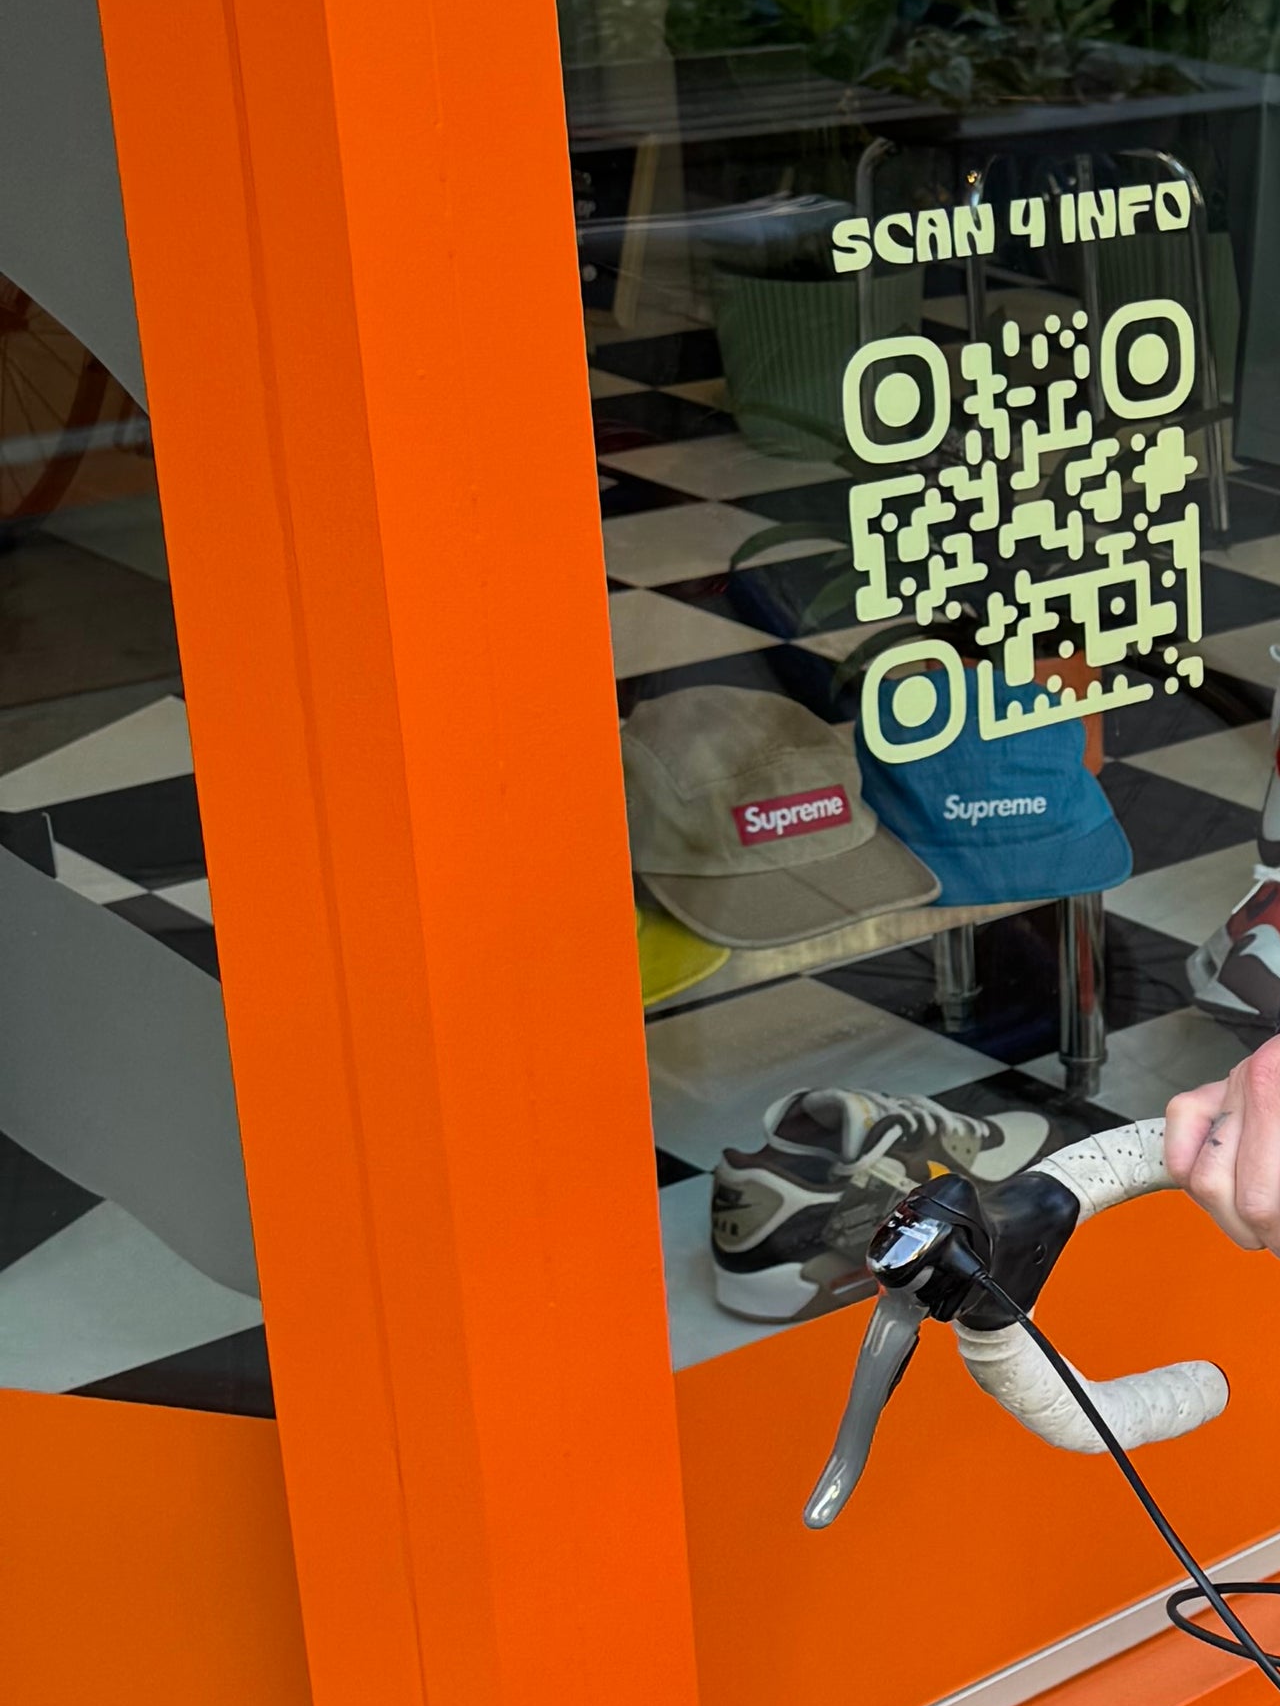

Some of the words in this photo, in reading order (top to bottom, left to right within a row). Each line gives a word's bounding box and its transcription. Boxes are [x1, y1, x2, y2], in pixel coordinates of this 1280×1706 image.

[831, 203, 996, 274] SCAN
[1008, 197, 1047, 248] 4
[1060, 180, 1191, 244] INFO
[744, 795, 844, 836] Supreme
[943, 794, 1047, 827] Supreme
